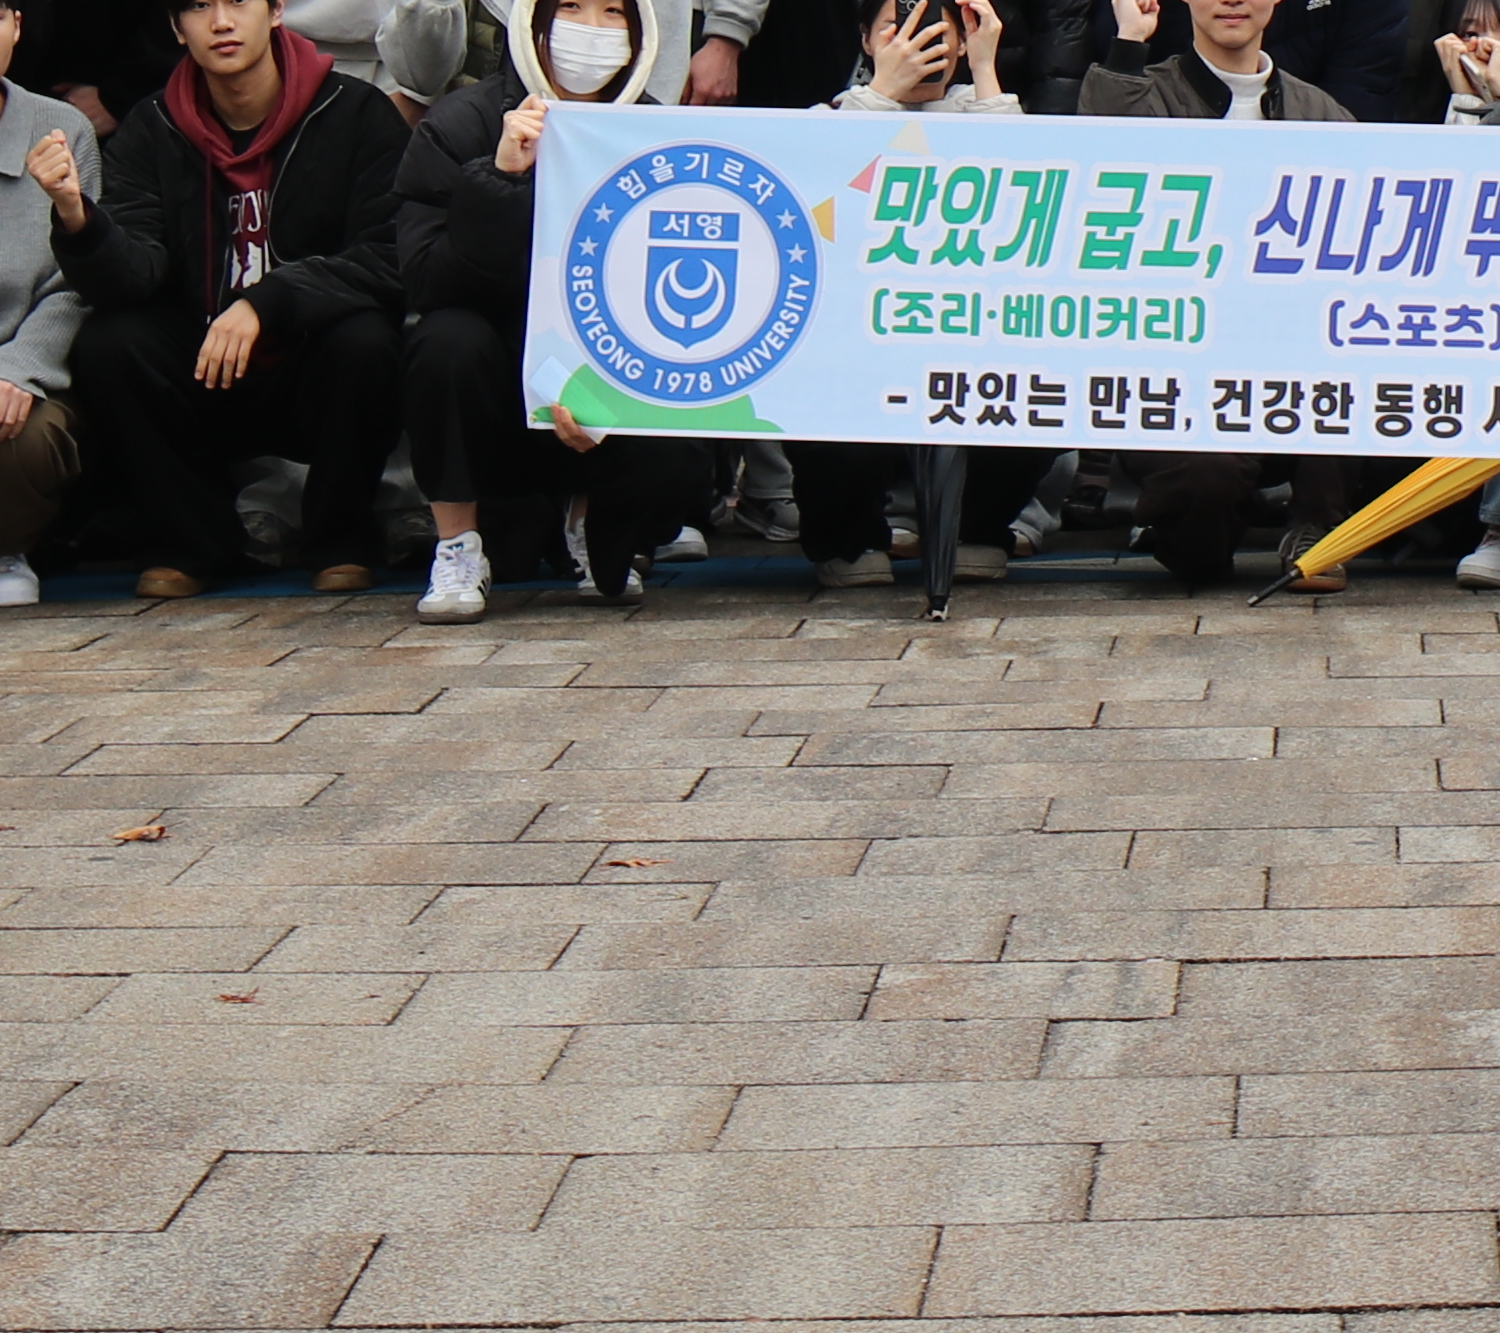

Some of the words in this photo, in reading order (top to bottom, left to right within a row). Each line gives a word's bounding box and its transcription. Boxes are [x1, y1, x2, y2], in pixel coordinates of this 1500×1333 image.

[662, 213, 723, 240] 서영
[867, 165, 1070, 267] 맛있게
[1079, 171, 1225, 279] 굽고,
[1254, 174, 1454, 278] 신나게
[571, 264, 646, 381] SEOYEONG
[654, 368, 714, 394] 1978
[720, 274, 812, 387] UNIVERSITY
[872, 287, 1207, 345] (조리·베이커리)
[928, 371, 1067, 428] 맛있는
[1088, 375, 1194, 432] 만남,
[1212, 379, 1355, 436] 건강한
[1374, 382, 1464, 440] 동행
